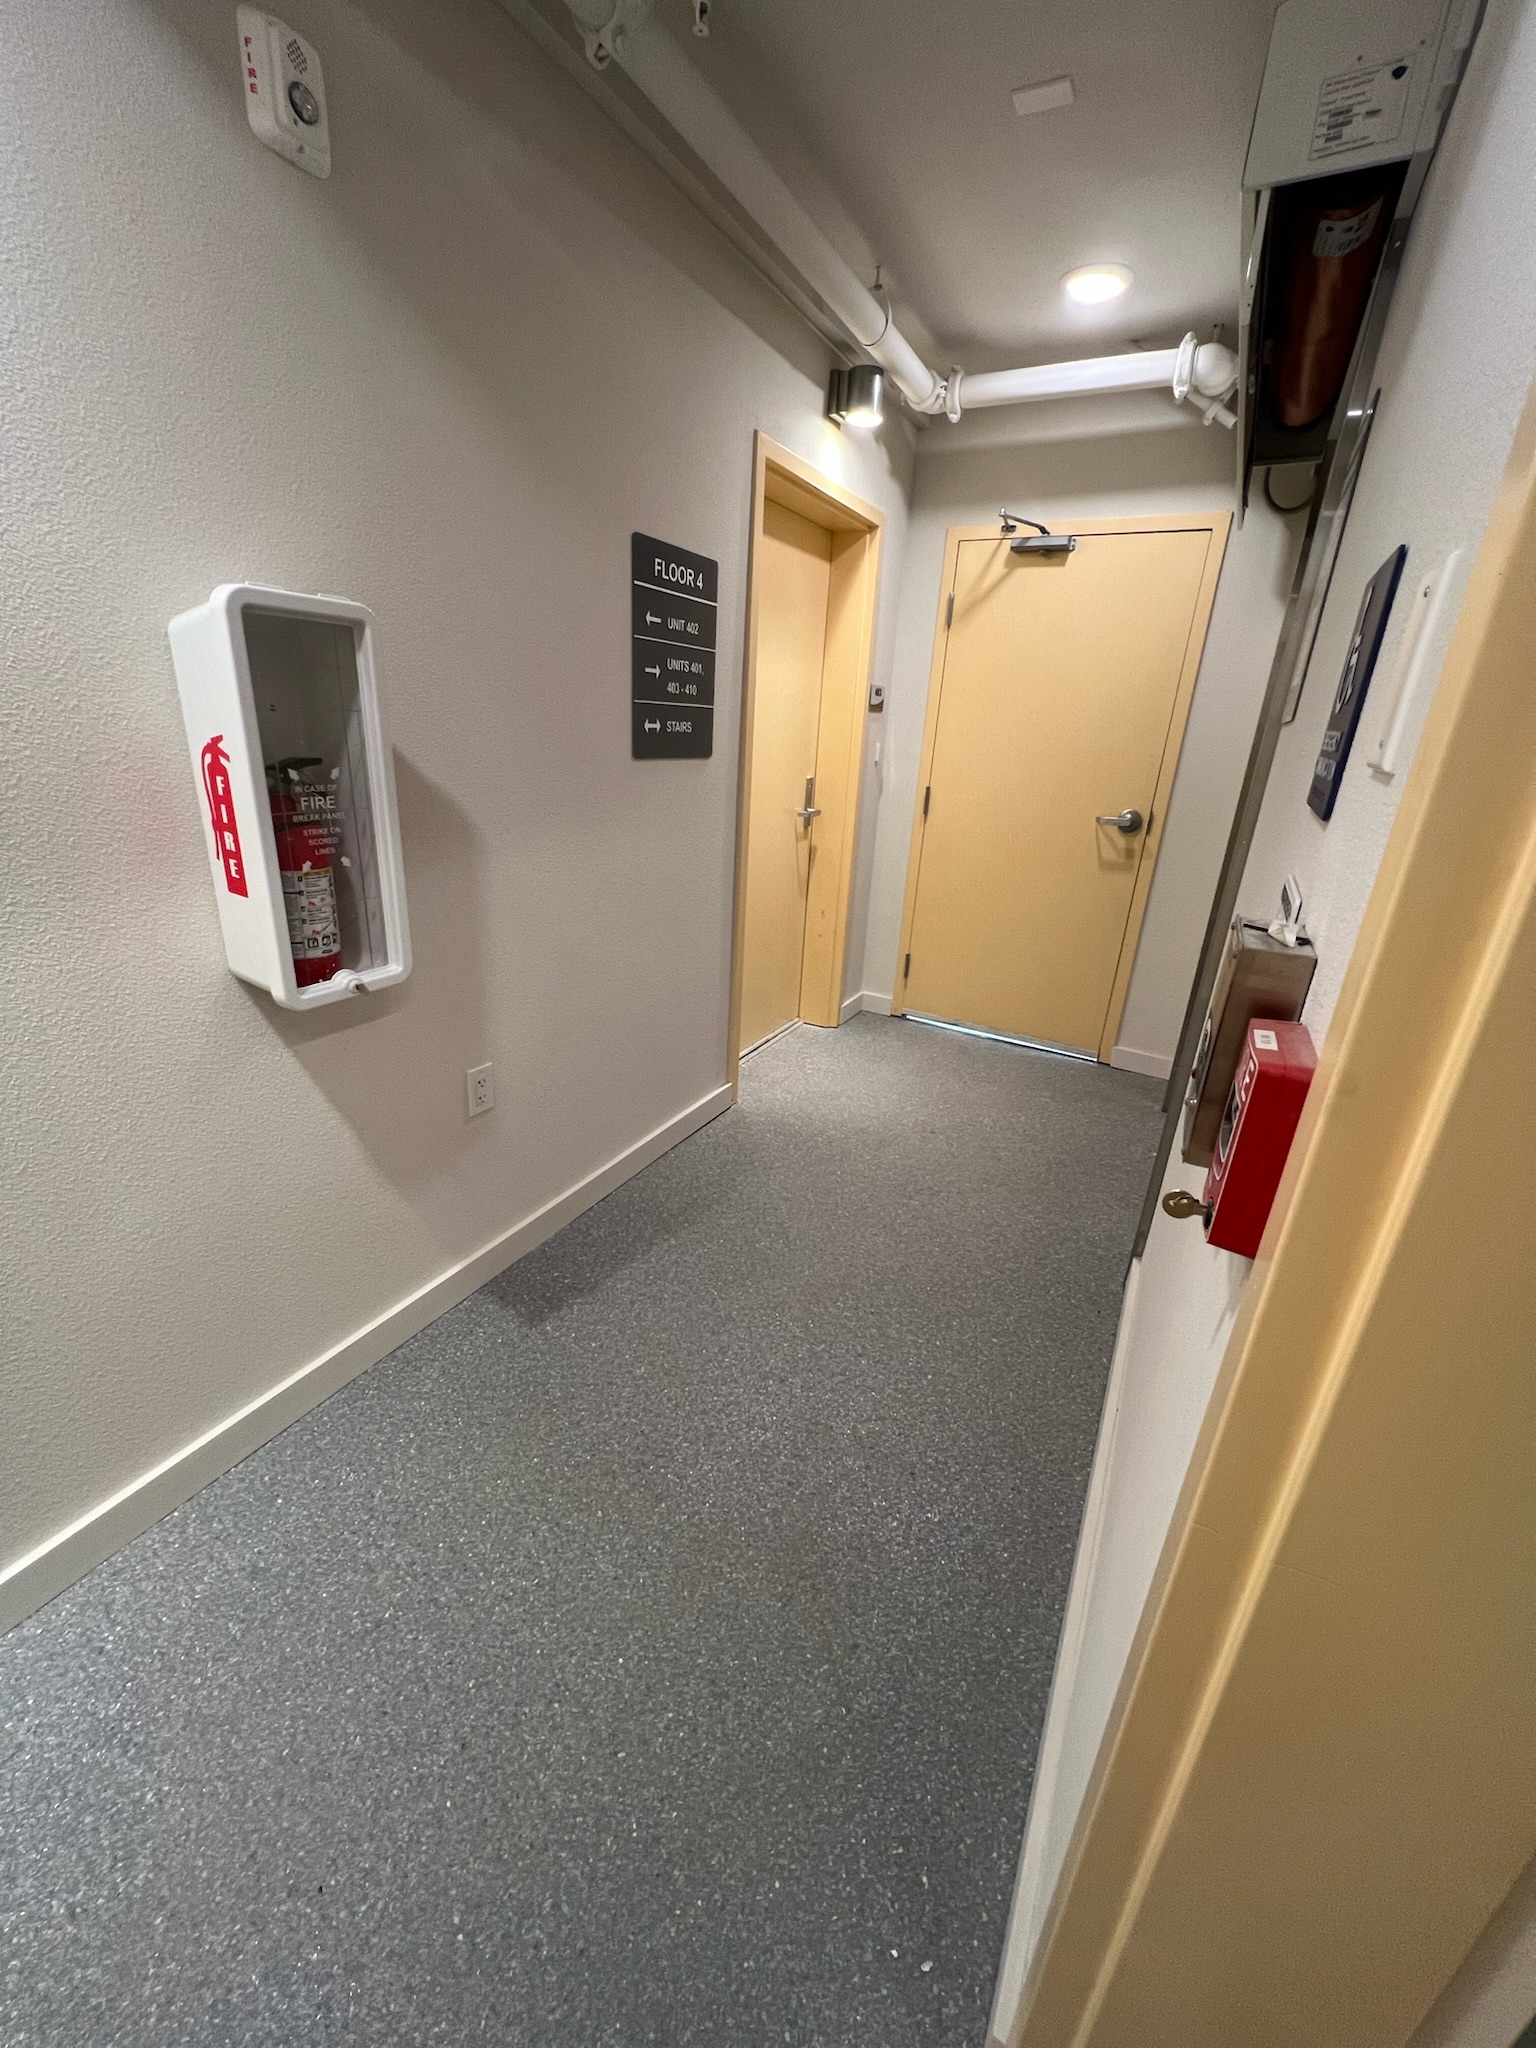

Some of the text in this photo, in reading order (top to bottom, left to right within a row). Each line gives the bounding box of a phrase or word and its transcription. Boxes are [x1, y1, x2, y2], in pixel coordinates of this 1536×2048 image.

[244, 36, 258, 93] FIRE
[654, 558, 704, 590] FLOOR 4
[667, 617, 699, 635] UNIT 402
[667, 658, 690, 673] UNITS
[667, 682, 679, 695] 403
[684, 683, 697, 696] 410
[666, 721, 692, 733] STAIRS
[295, 784, 337, 793] IN CASE OF
[300, 796, 336, 811] FIRE
[292, 812, 346, 823] BREAK PANEL
[215, 775, 240, 879] FIRE
[303, 826, 341, 837] STRIKE ON
[308, 837, 339, 846] SCORED
[314, 847, 336, 856] LINES
